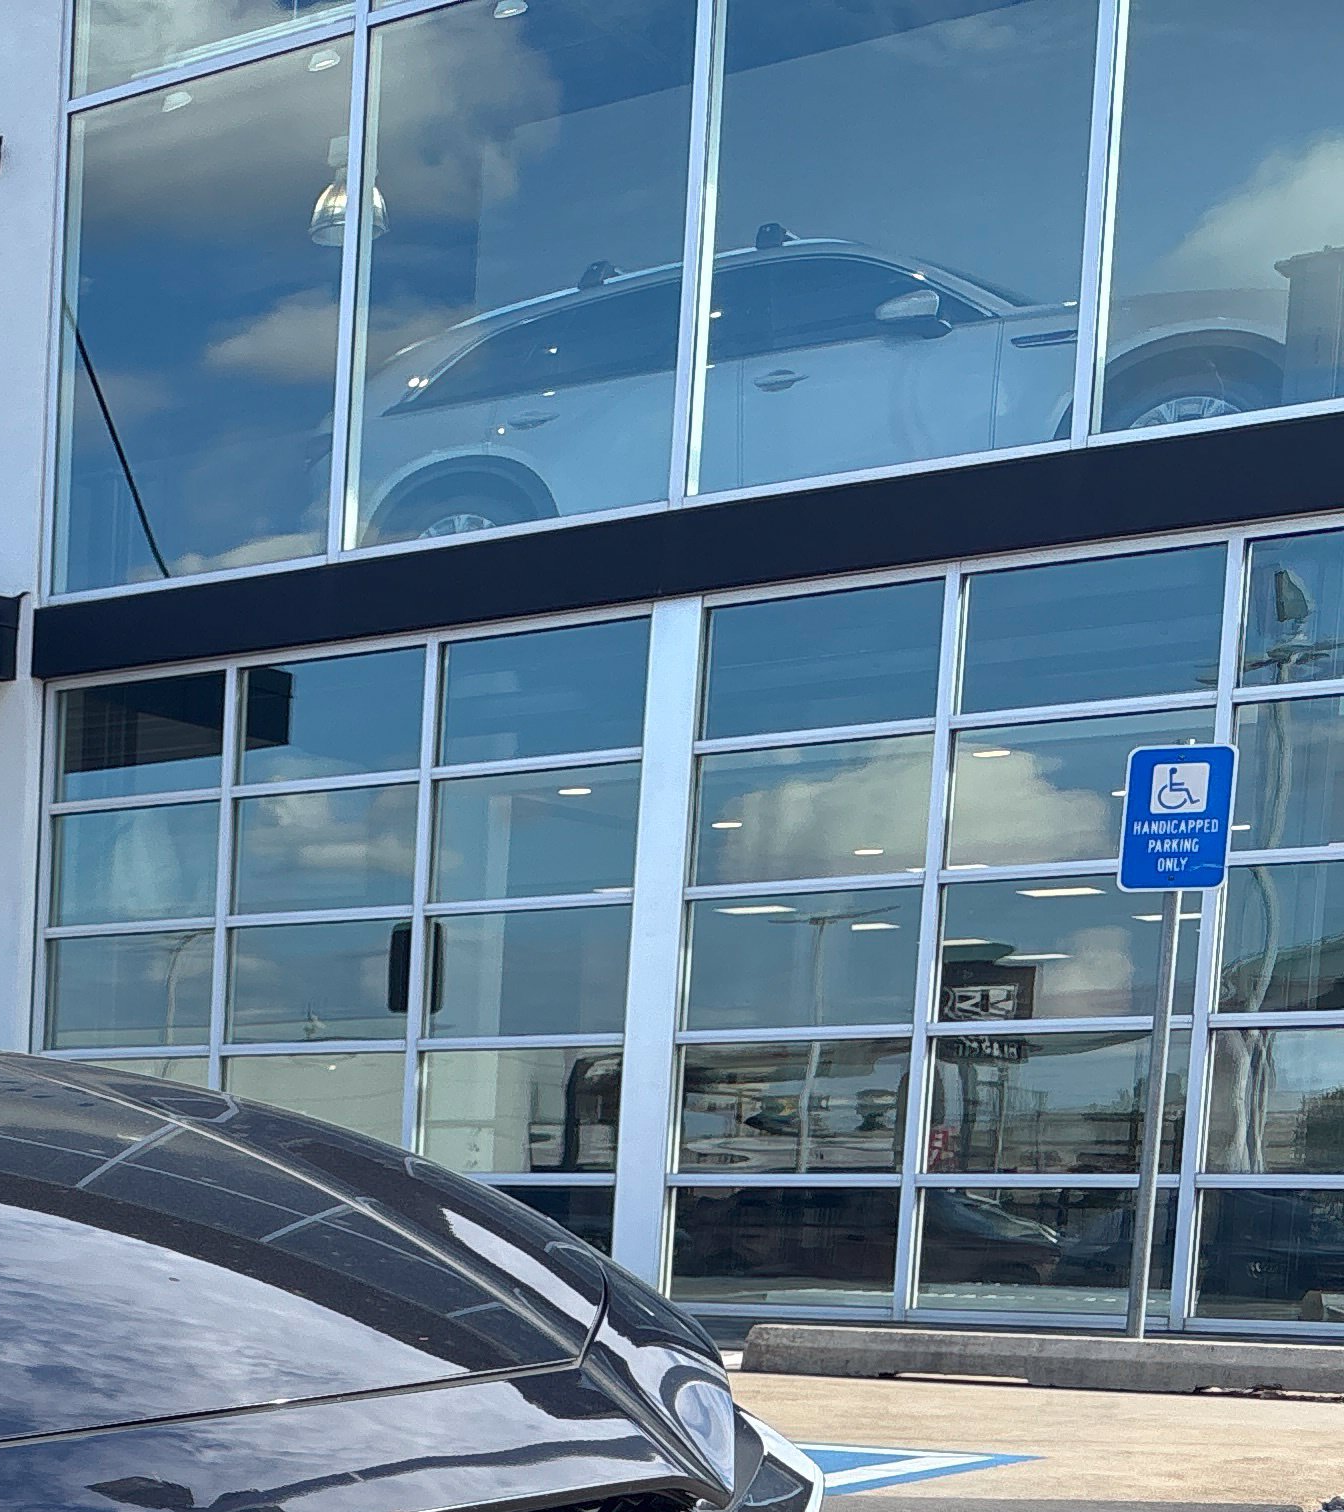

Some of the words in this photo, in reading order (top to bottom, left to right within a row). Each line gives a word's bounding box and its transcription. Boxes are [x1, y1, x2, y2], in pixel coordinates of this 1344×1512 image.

[1133, 819, 1219, 835] HANDICAPPED
[1148, 838, 1199, 853] PARKING
[1157, 857, 1188, 872] ONLY
